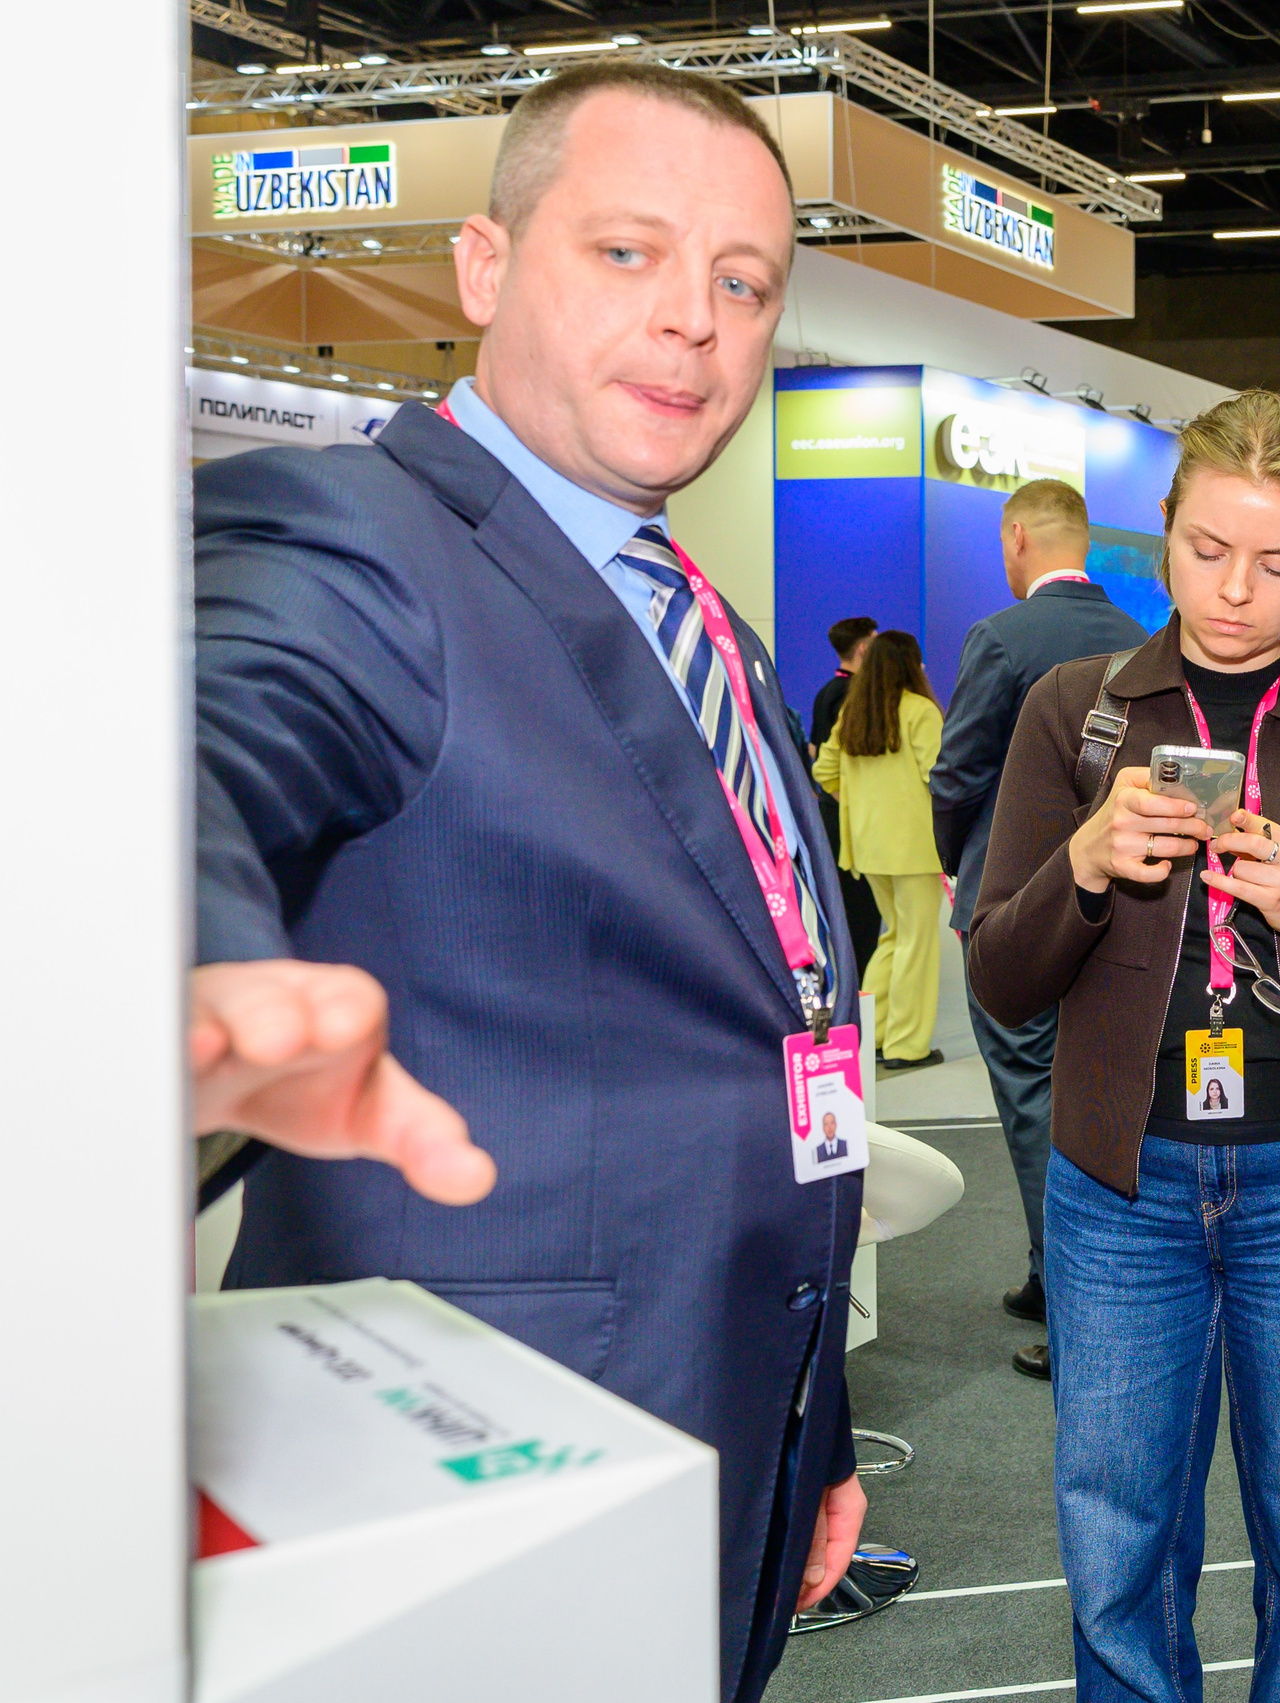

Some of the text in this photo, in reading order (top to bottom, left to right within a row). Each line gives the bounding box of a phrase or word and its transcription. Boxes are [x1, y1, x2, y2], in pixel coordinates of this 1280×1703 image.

[212, 153, 236, 215] MADE
[236, 166, 391, 212] UZBEKISTAN
[947, 165, 963, 230] MADE
[962, 195, 1054, 265] UZBEKISTAN
[200, 398, 316, 430] ПОЛИПЛАСТ
[793, 1052, 808, 1127] EXHIBITOR
